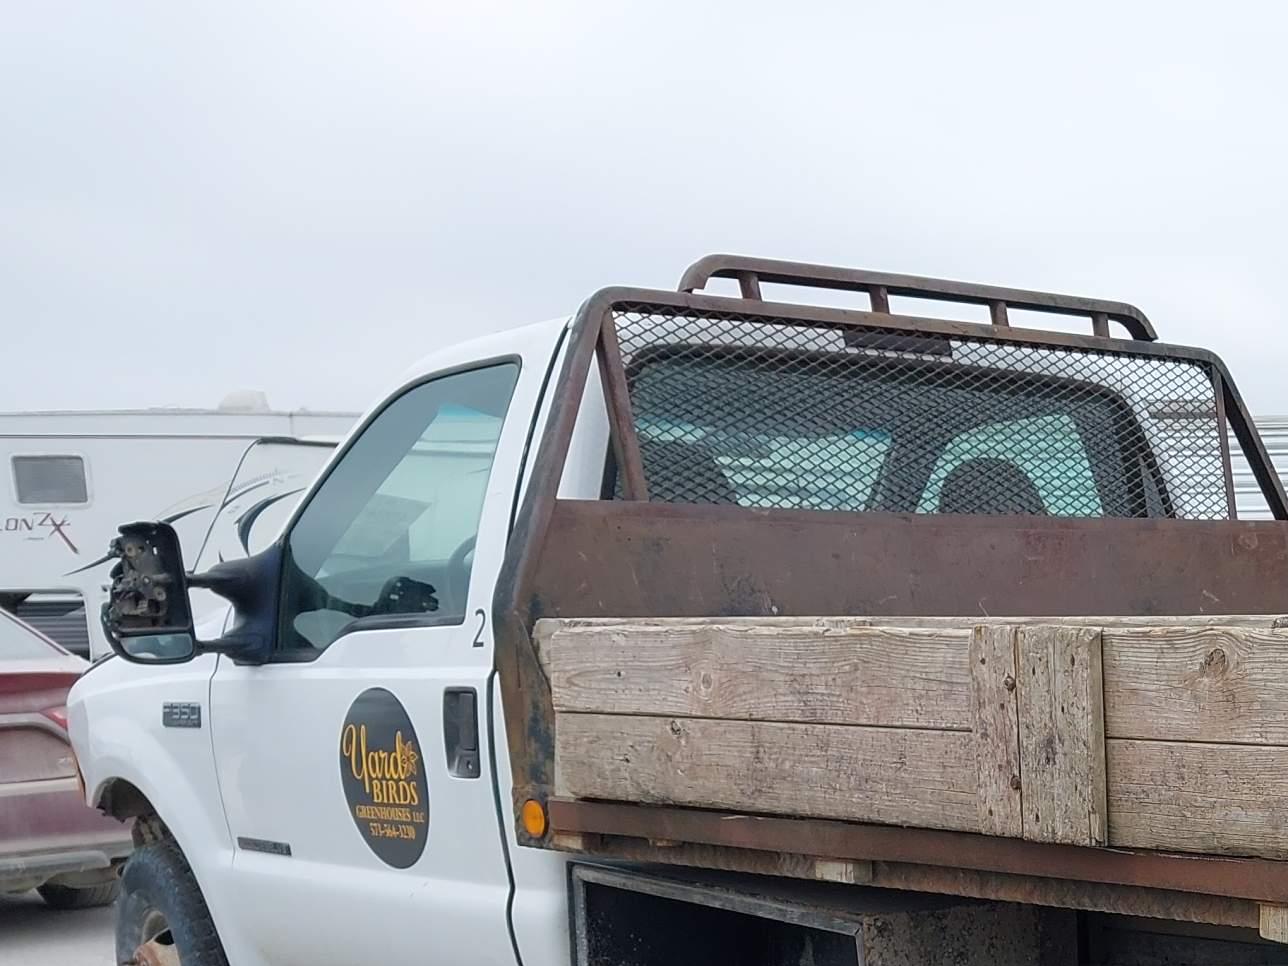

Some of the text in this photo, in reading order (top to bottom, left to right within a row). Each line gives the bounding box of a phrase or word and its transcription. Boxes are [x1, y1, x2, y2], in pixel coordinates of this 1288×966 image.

[473, 608, 486, 648] 2
[342, 724, 406, 793] Yard
[373, 779, 419, 806] BIRDS
[356, 805, 425, 823] GREENHOUSES LLC
